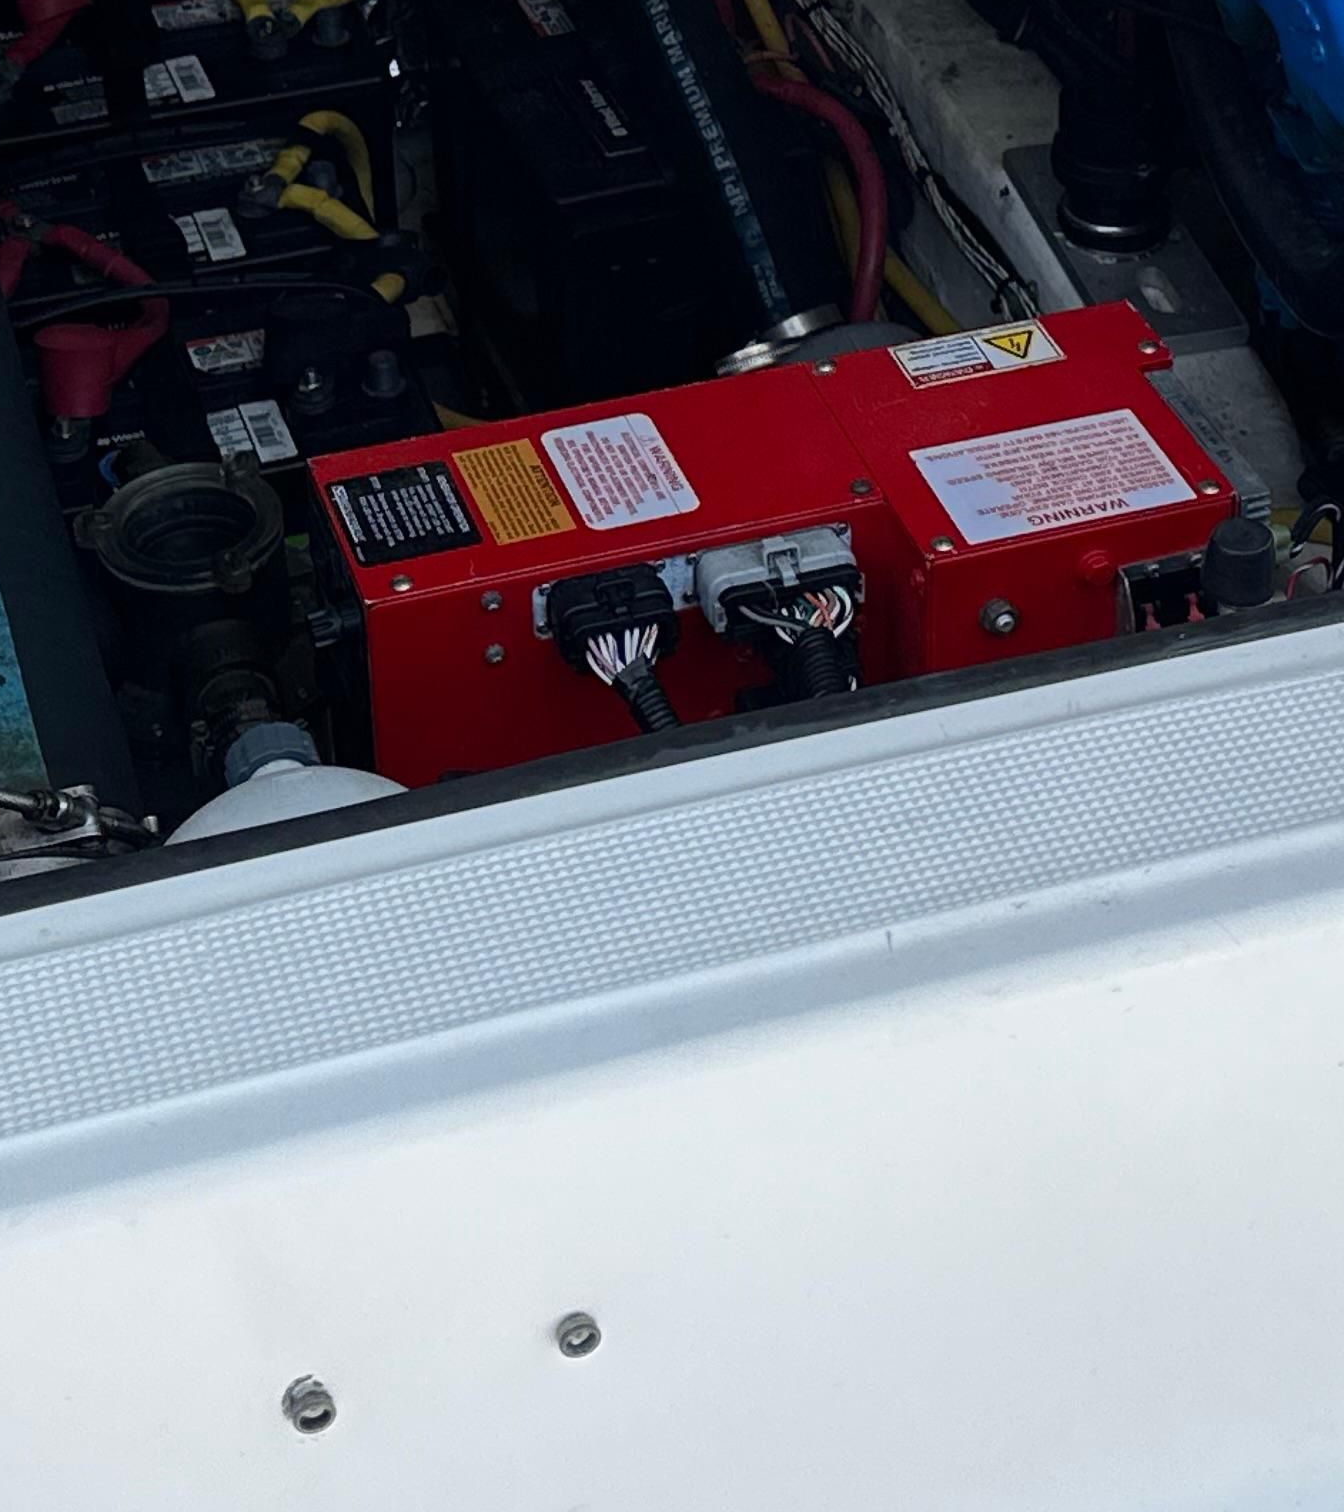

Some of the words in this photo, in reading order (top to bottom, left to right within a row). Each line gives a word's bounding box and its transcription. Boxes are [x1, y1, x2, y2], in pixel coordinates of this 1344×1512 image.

[676, 65, 738, 170] PREMIUM
[724, 174, 750, 217] MPI
[649, 445, 686, 492] WARNING
[1025, 496, 1130, 527] WARNING
